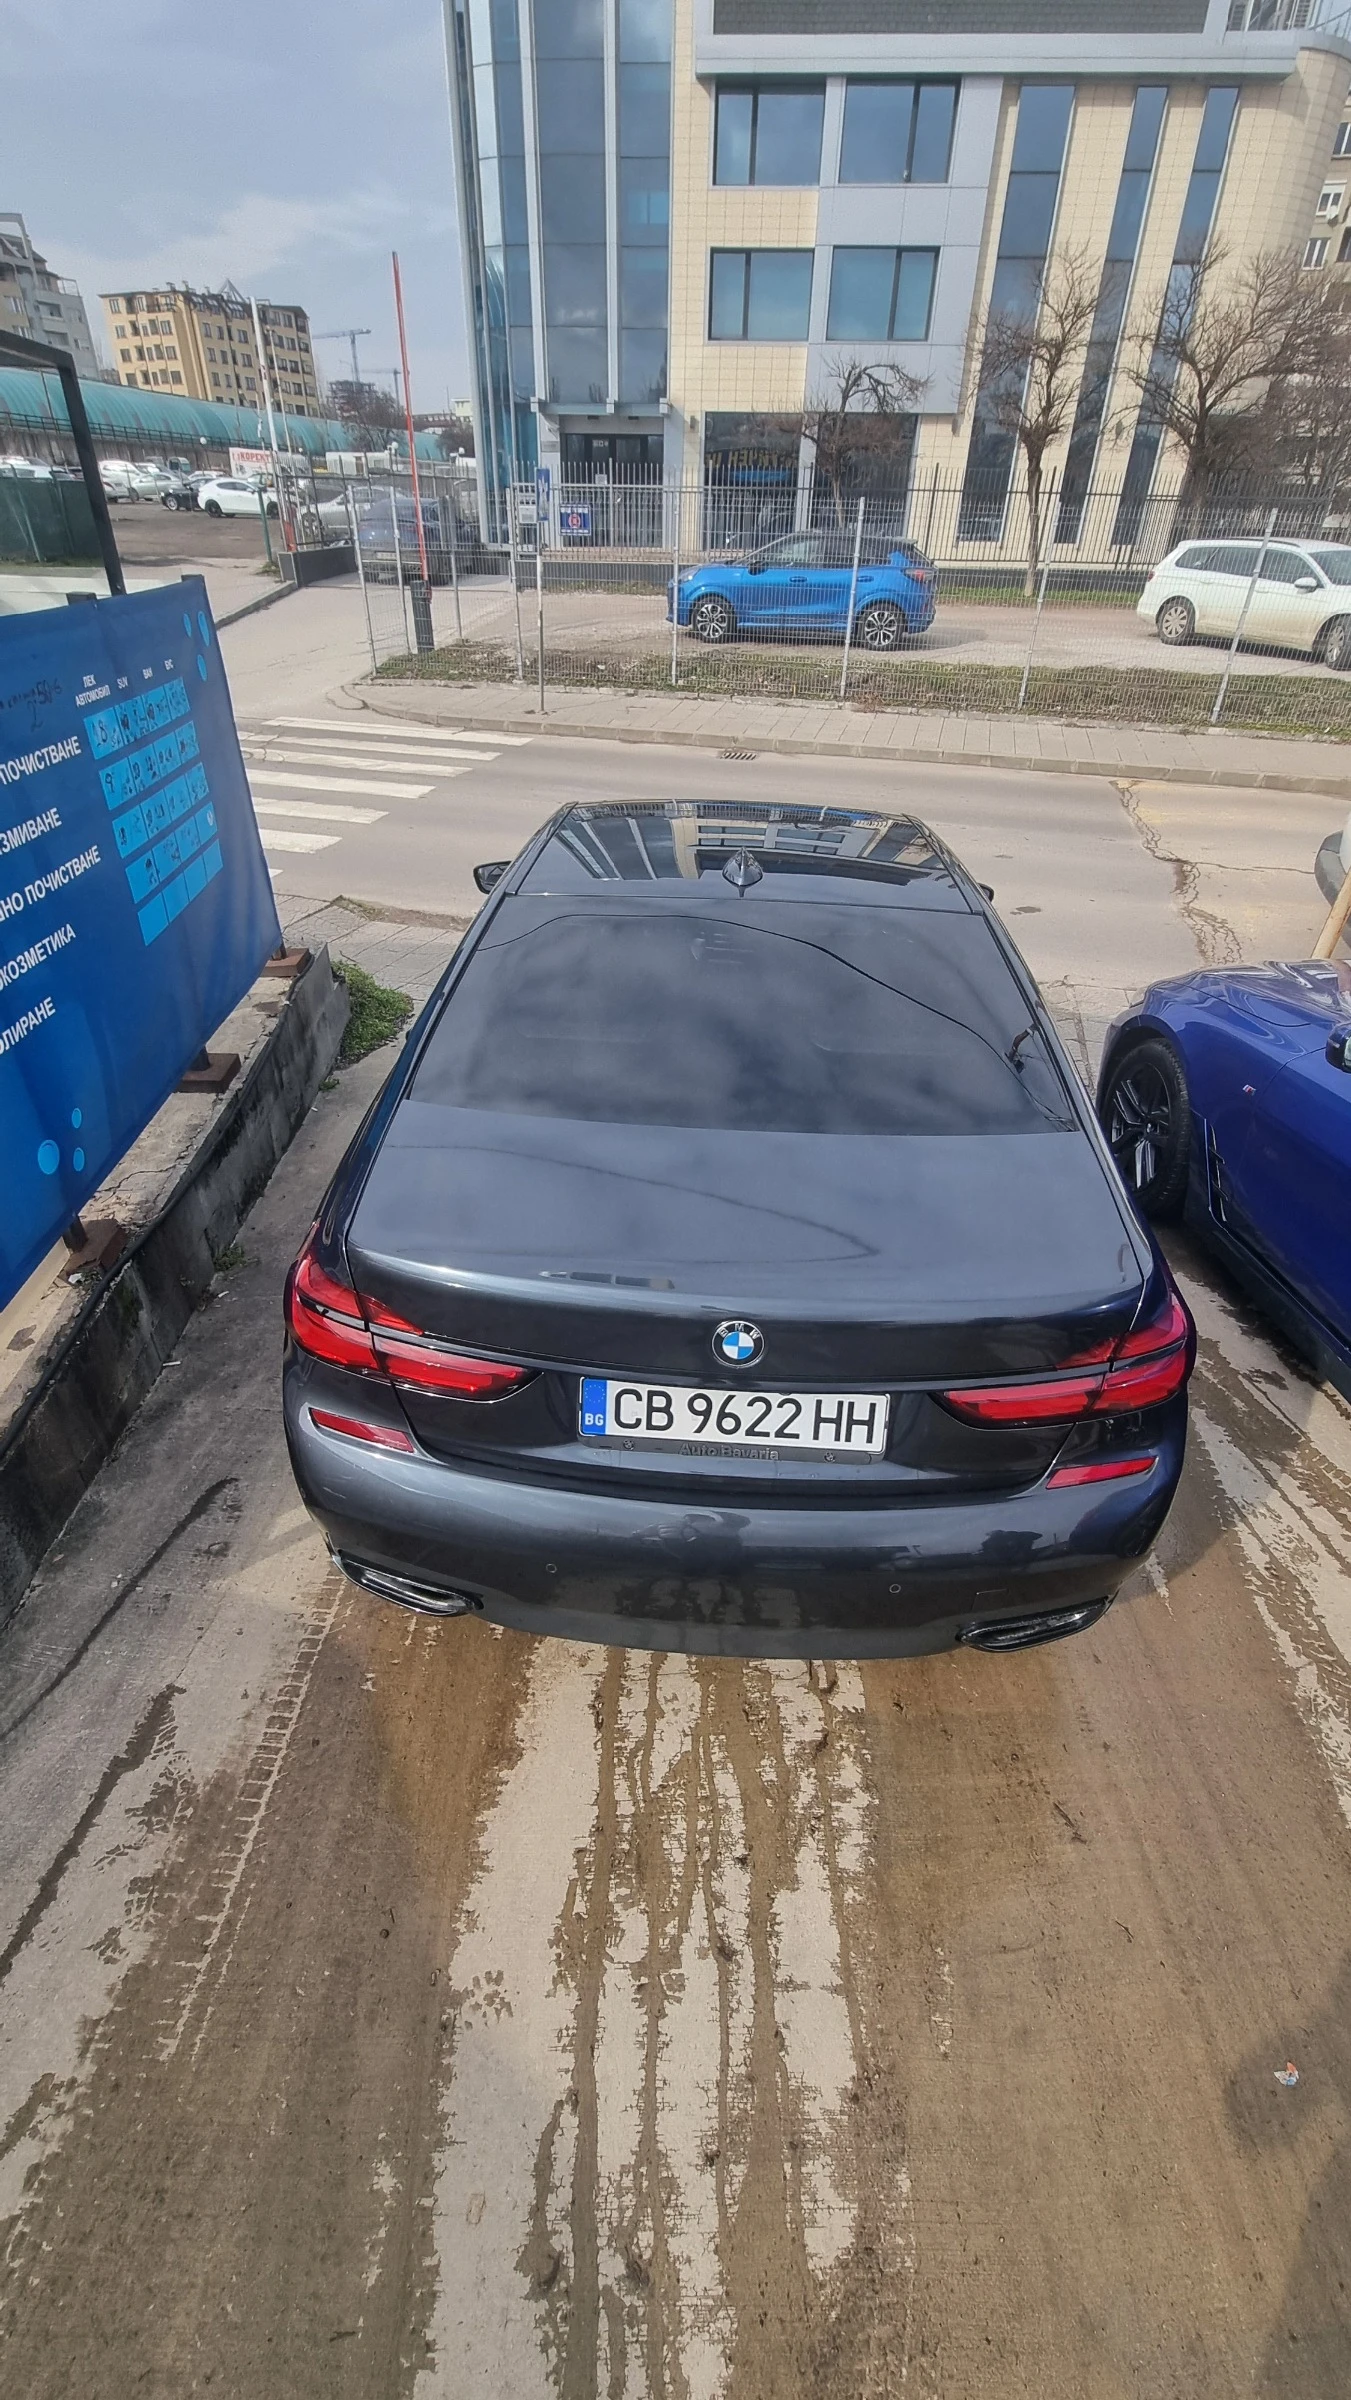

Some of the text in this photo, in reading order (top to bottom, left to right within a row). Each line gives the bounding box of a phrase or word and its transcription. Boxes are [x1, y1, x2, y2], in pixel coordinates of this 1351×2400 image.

[82, 674, 96, 688] ЛЕК
[116, 676, 129, 689] SUV
[75, 684, 111, 707] АВТОМОБИЛ
[0, 735, 82, 785] ПОЧИСТВАНЕ
[0, 807, 62, 855] ЗМИВАНЕ
[24, 845, 101, 905] ПОЧИСТВАНЕ
[584, 1412, 604, 1426] BG
[614, 1388, 878, 1444] CB 9622 HH
[678, 1443, 779, 1461] Auto Bavaria
